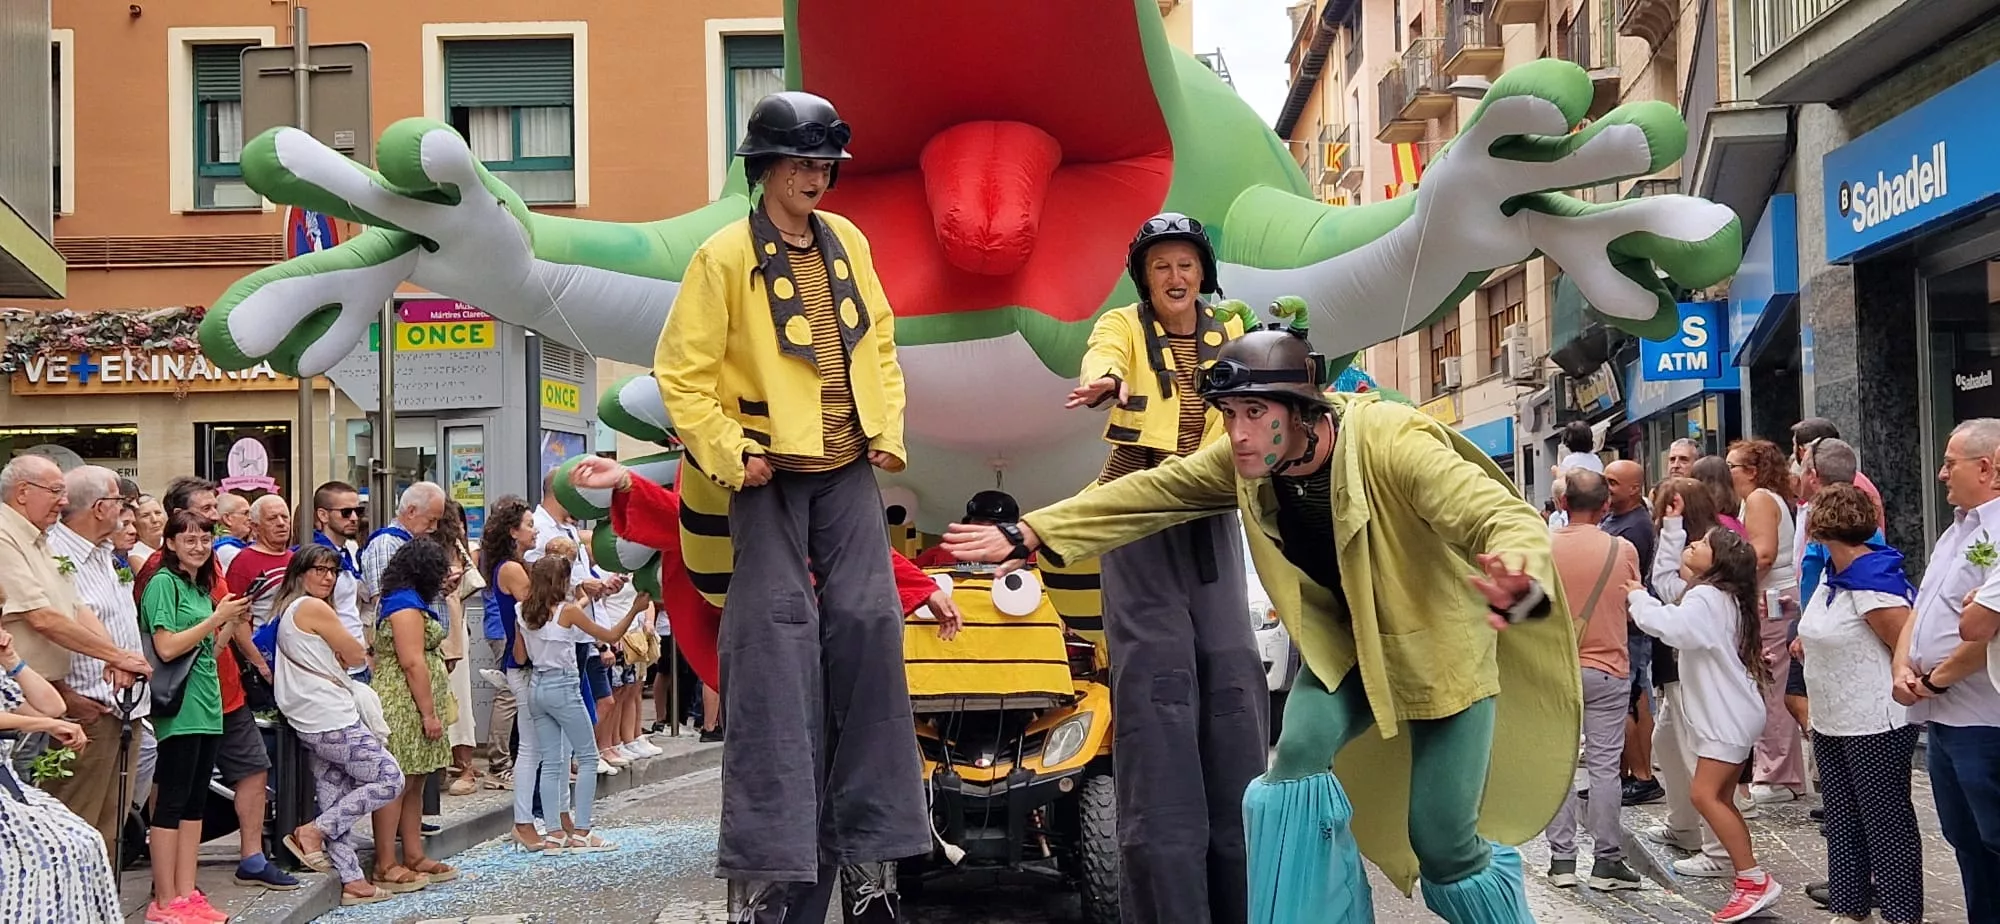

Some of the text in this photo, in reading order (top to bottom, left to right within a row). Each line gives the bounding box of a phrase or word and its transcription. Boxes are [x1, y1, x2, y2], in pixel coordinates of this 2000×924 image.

[1852, 141, 1948, 233] Sabadell
[430, 310, 461, 319] Mártires
[407, 324, 484, 345] ONCE
[1681, 316, 1708, 347] S
[1657, 351, 1708, 372] ATM
[546, 384, 576, 408] ONCE
